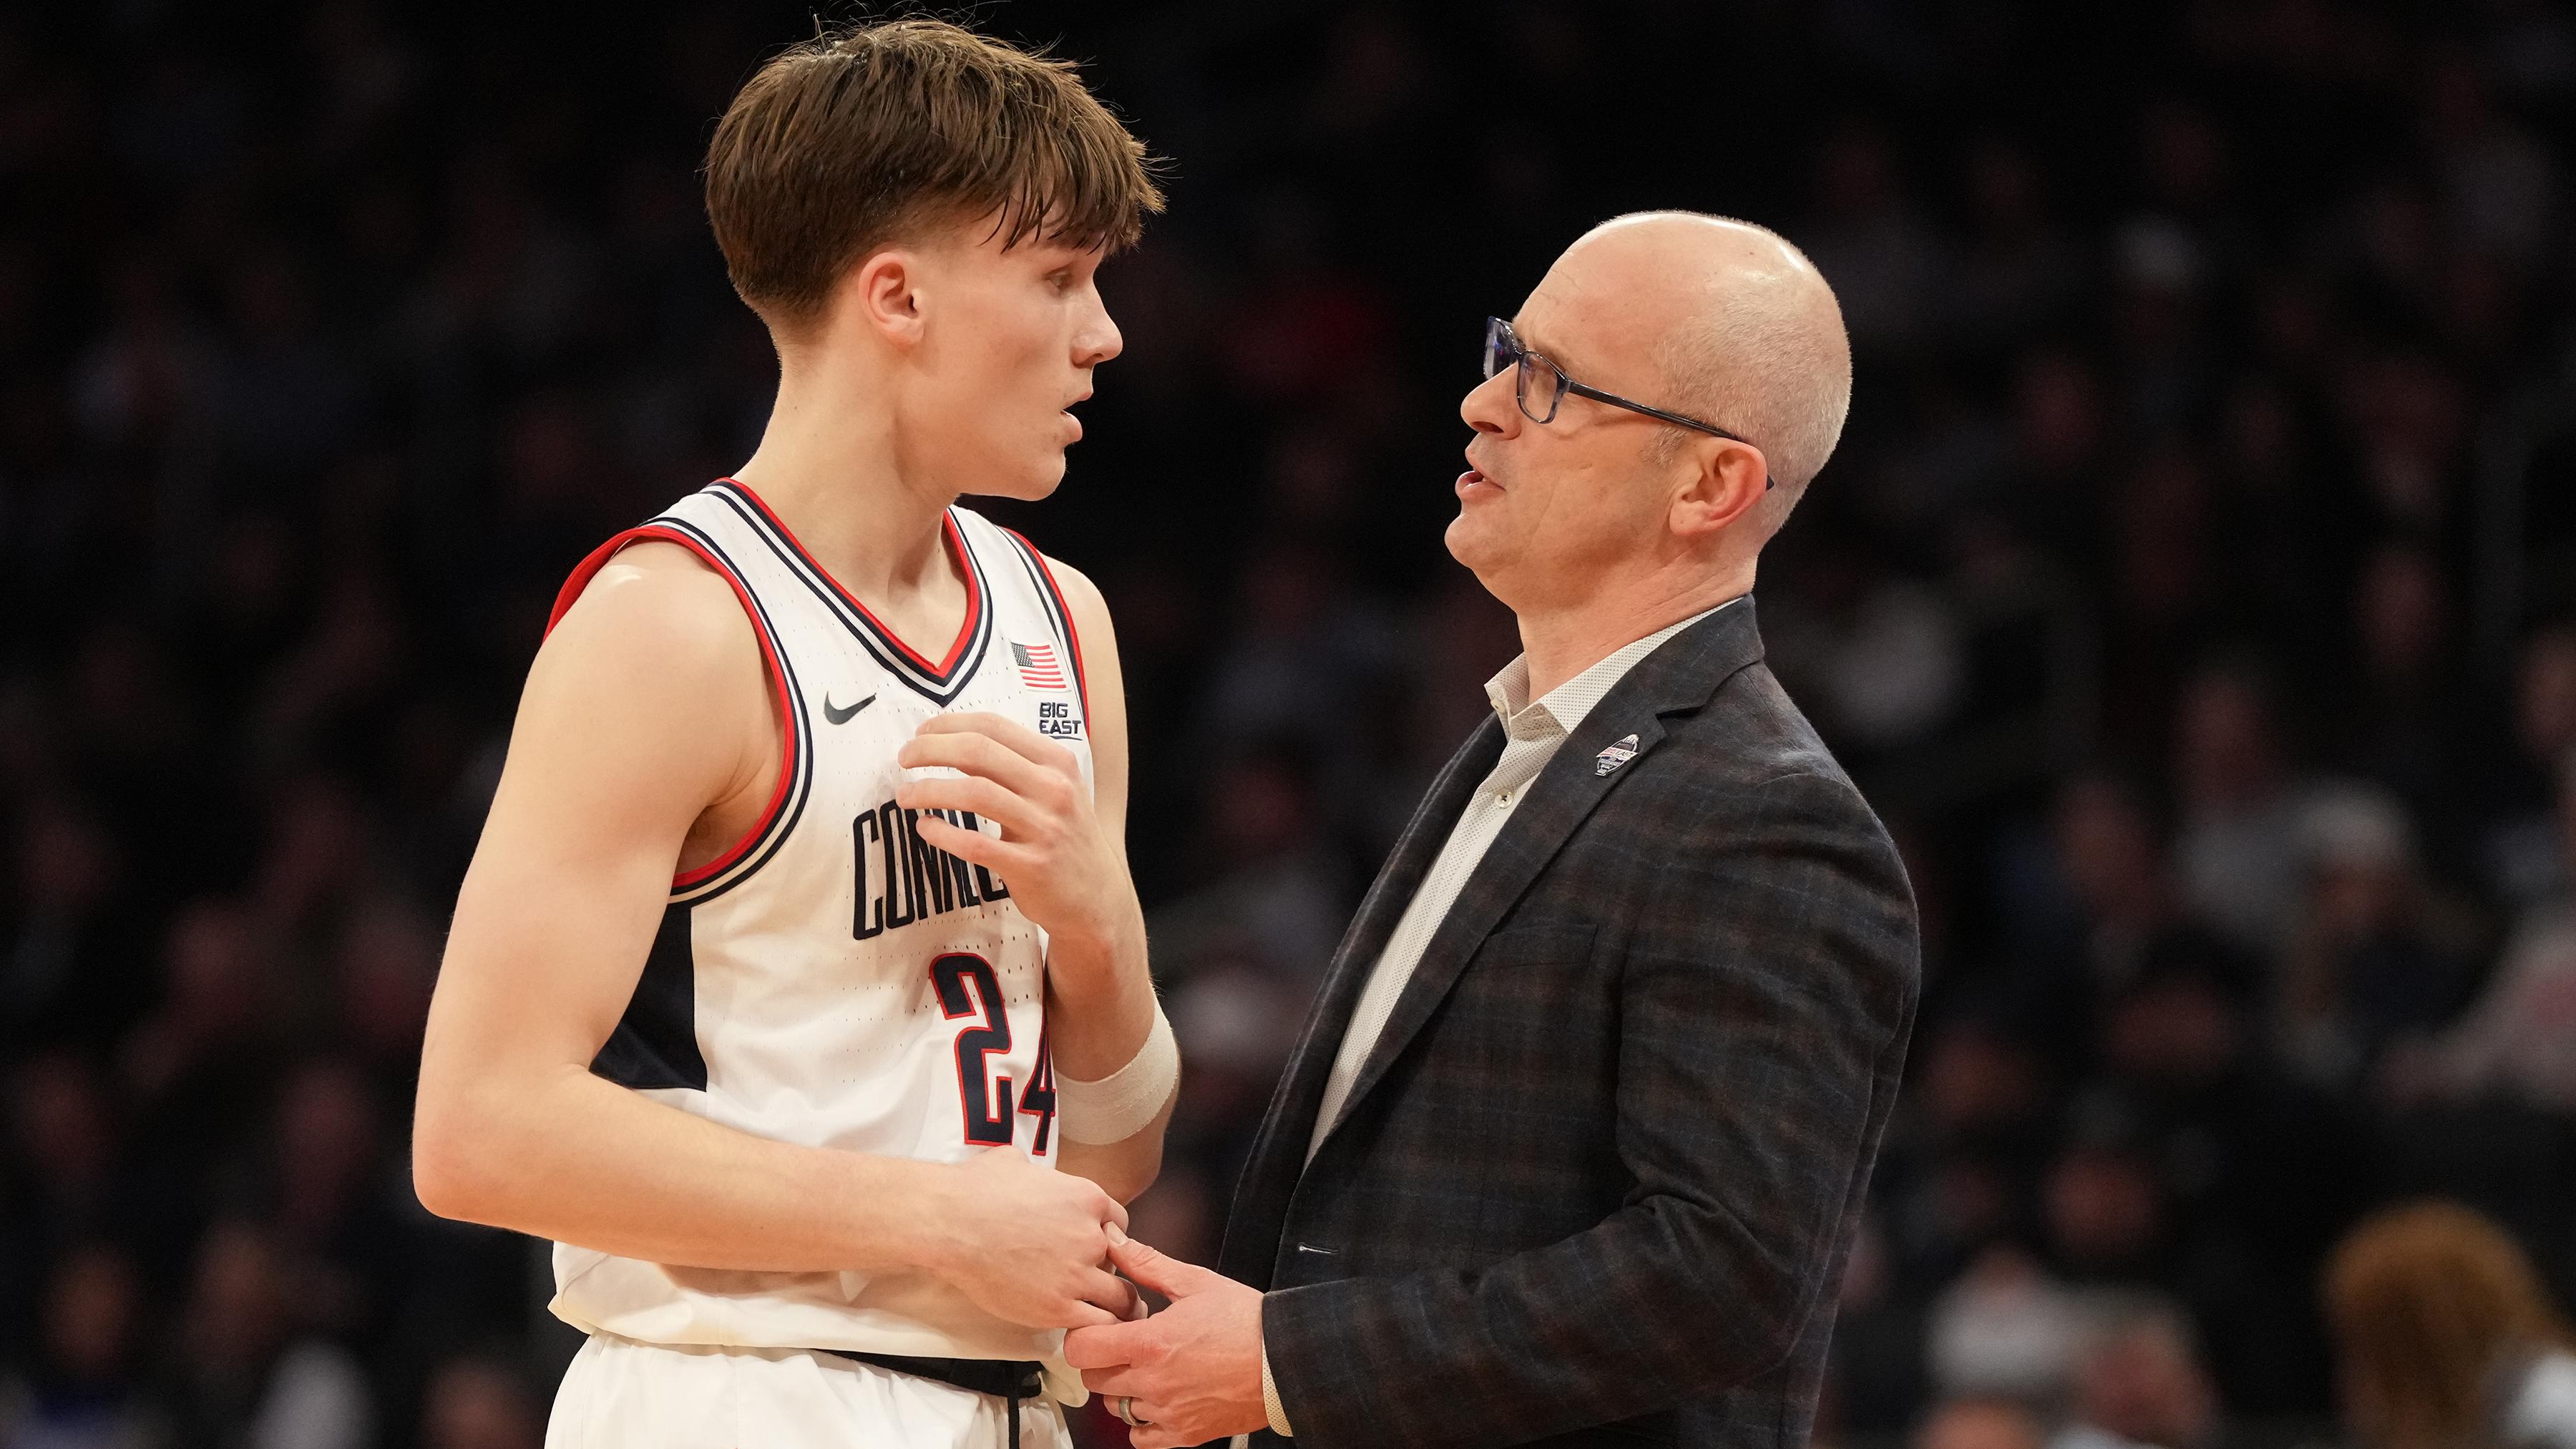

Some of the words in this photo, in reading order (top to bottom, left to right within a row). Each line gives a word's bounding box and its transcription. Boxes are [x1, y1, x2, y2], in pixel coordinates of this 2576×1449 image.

[1040, 702, 1068, 718] BIG
[1039, 720, 1081, 734] EAST
[929, 952, 1056, 1156] 24
